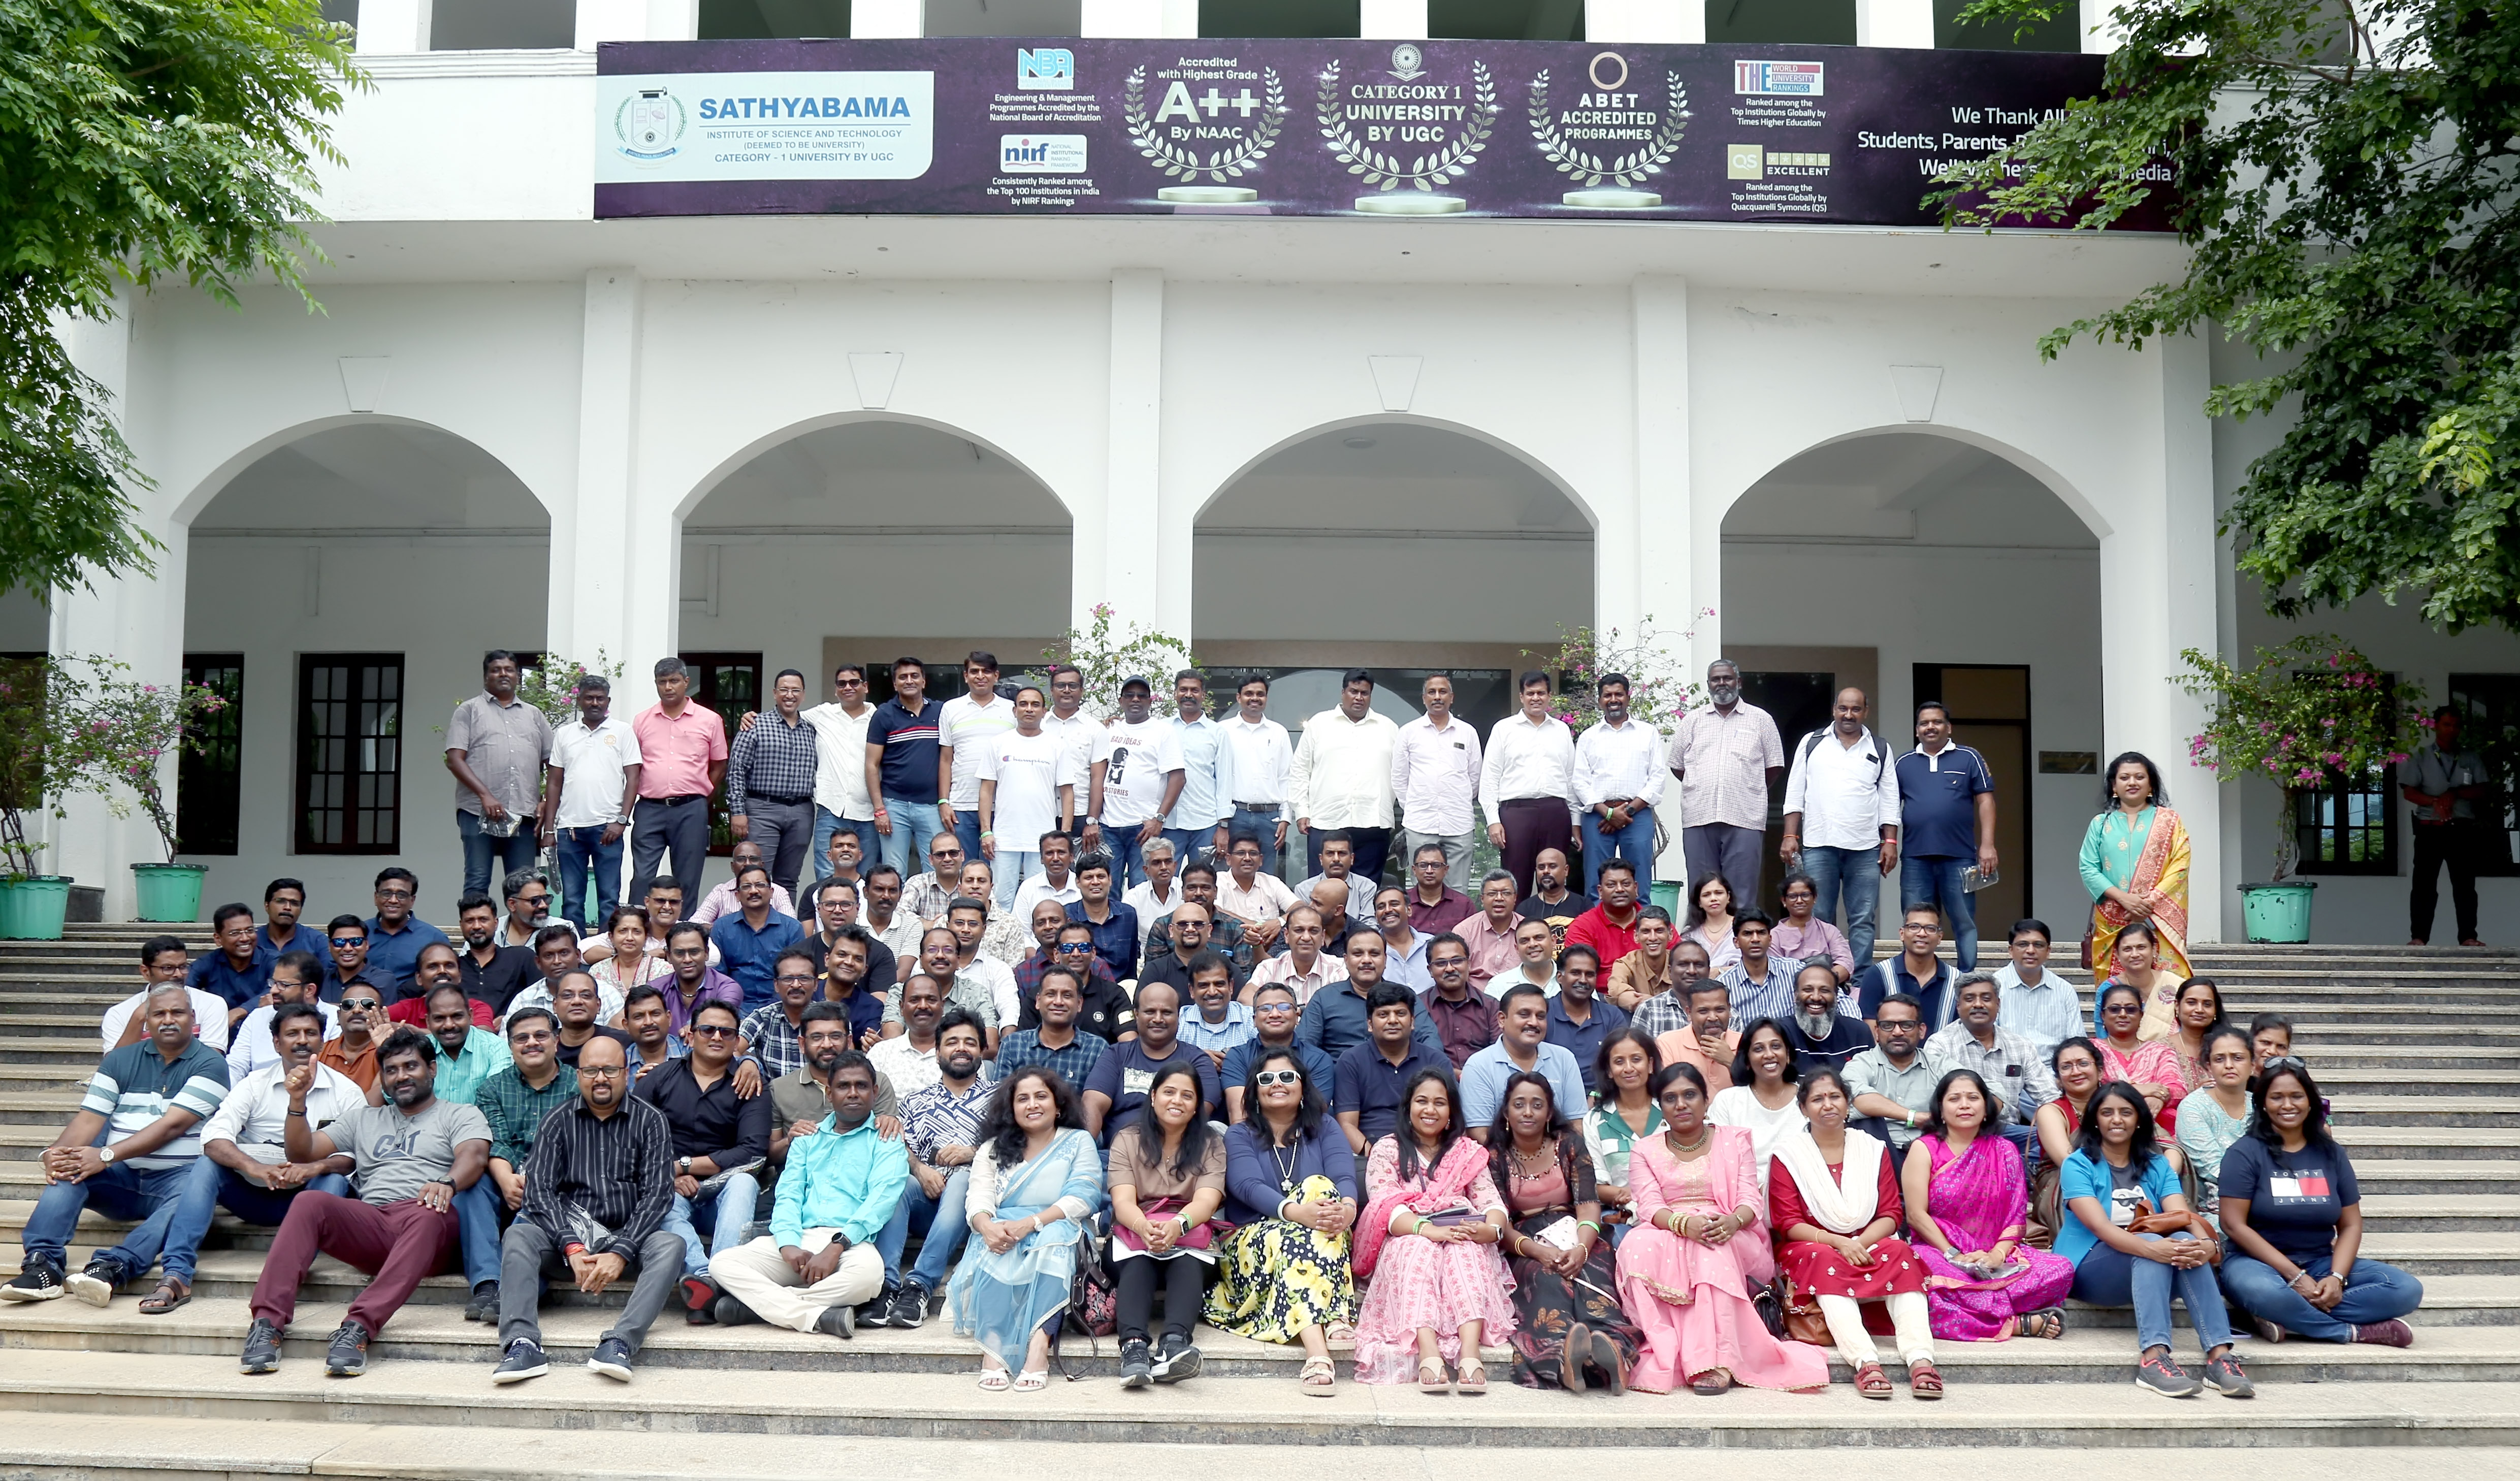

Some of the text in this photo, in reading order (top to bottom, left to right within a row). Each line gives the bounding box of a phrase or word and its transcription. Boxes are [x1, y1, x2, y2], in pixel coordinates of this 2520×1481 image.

[1018, 48, 1074, 78] NBA
[1178, 57, 1237, 67] Accredited
[1157, 70, 1258, 81] with Highest Grade
[1737, 63, 1771, 91] THE
[1351, 85, 1461, 99] CATEGORY 1
[995, 94, 1038, 103] Engineering
[1047, 94, 1095, 103] Management
[1154, 81, 1261, 123] A++
[699, 97, 911, 119] SATHYABAMA
[990, 104, 1036, 113] Programmes
[1077, 104, 1086, 113] by
[1346, 105, 1466, 121] UNIVERSITY
[1731, 108, 1826, 118] Top Institutions Globally by
[1561, 111, 1657, 125] ACCREDITED
[1952, 107, 1981, 123] We
[1985, 108, 2039, 124] Thank
[1761, 118, 1785, 127] Higher
[1171, 126, 1243, 141] By NAAC
[1368, 126, 1444, 142] BY UGC
[1565, 128, 1652, 140] PROGRAMMES
[744, 142, 782, 150] (DEEMED
[812, 141, 864, 150] UNIVERSITY)
[1858, 131, 1937, 151] Students,
[1005, 139, 1049, 162] nirf
[715, 153, 771, 162] CATEGORY
[790, 153, 850, 161] UNIVERSITY
[1732, 154, 1758, 171] QS
[1767, 167, 1830, 176] EXCELLENT
[992, 177, 1037, 186] Consistently
[1000, 187, 1014, 196] Top
[1012, 197, 1020, 206] by
[1041, 197, 1075, 206] Rankings
[1731, 193, 1827, 203] Top Institutions Globally by
[1731, 203, 1827, 212] Quacquarelli Symonds (QS)
[1123, 737, 1142, 746] IDEAS
[1003, 755, 1050, 765] Champion
[1109, 787, 1128, 796] STORIES
